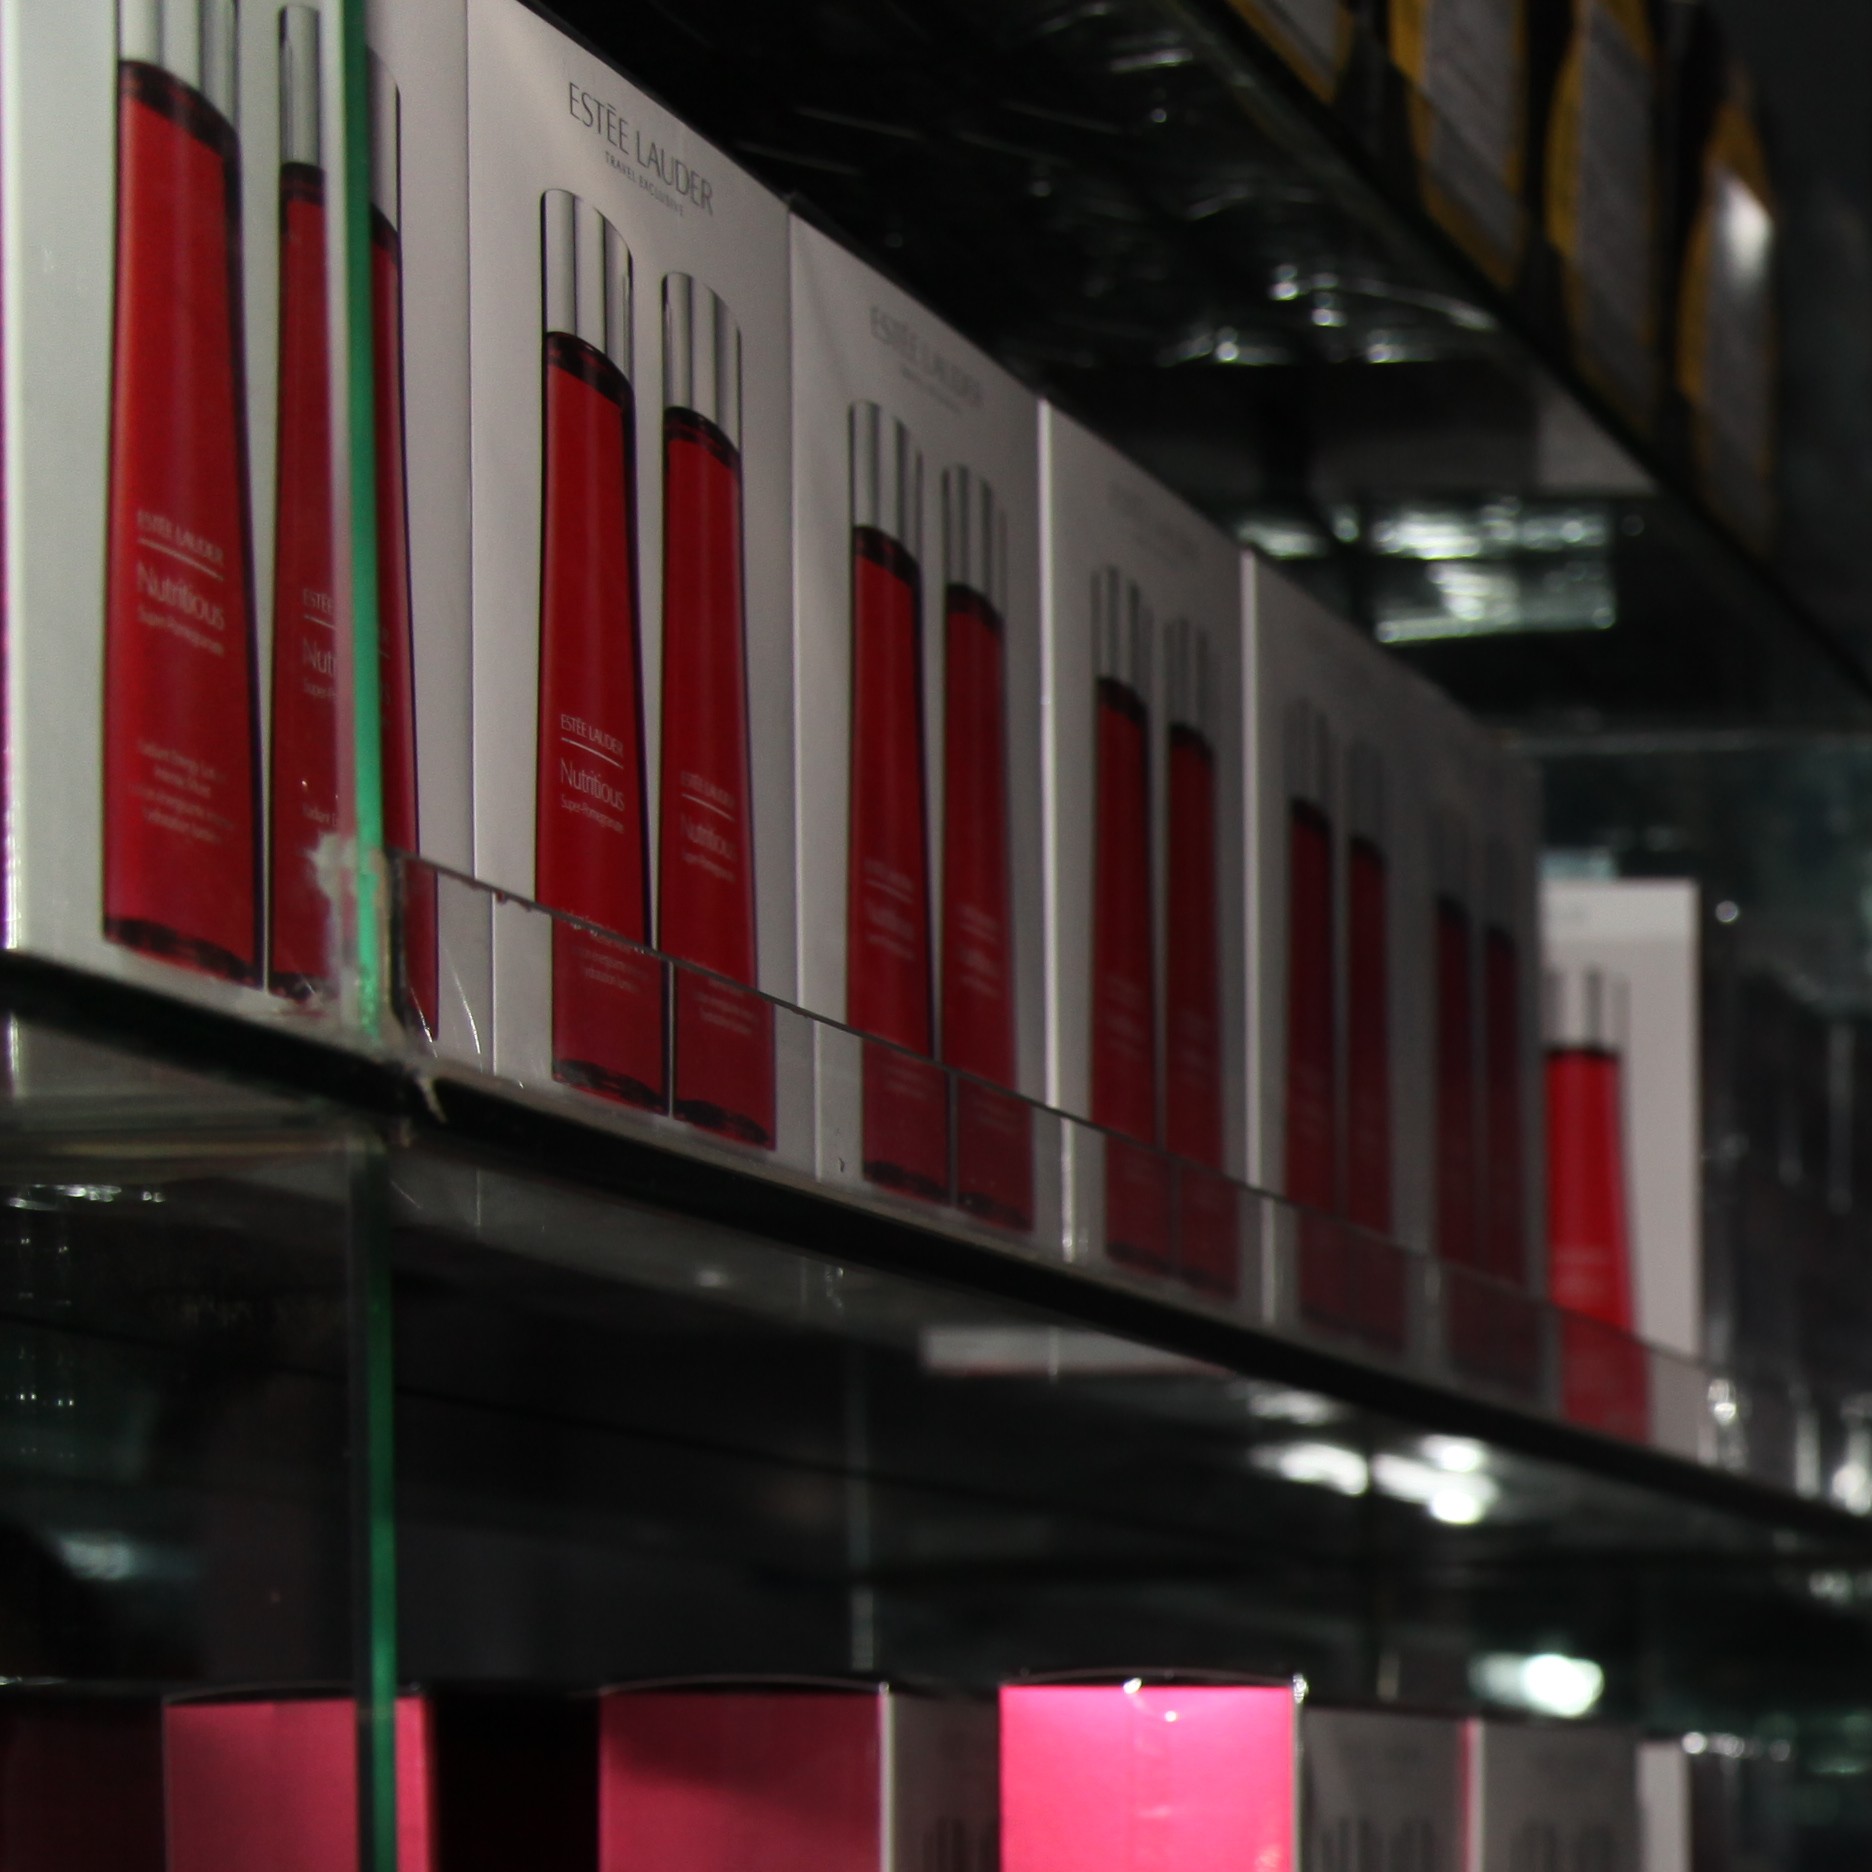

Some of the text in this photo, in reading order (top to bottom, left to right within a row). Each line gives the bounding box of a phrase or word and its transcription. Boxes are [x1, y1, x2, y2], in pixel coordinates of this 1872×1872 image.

[635, 130, 714, 218] LAUDER
[136, 560, 225, 632] Nutritious
[559, 758, 625, 813] Nutritious
